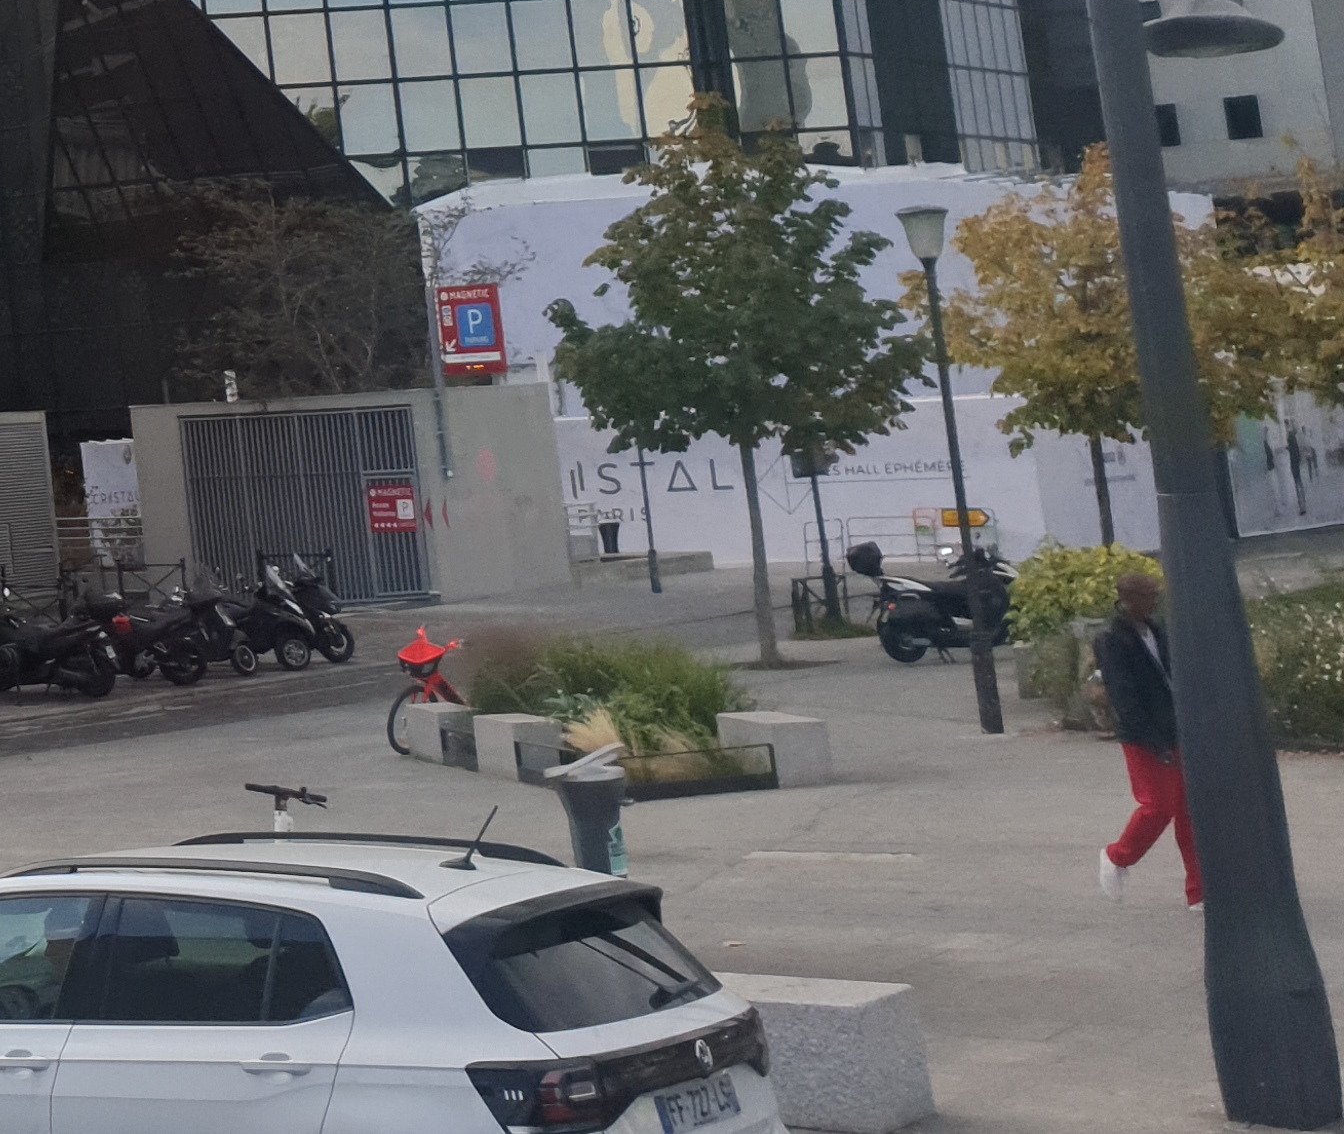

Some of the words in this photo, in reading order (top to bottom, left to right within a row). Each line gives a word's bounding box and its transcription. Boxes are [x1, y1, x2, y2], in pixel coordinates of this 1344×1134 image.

[449, 288, 490, 300] MAGNETIC
[467, 308, 483, 334] P
[844, 464, 879, 475] HALL
